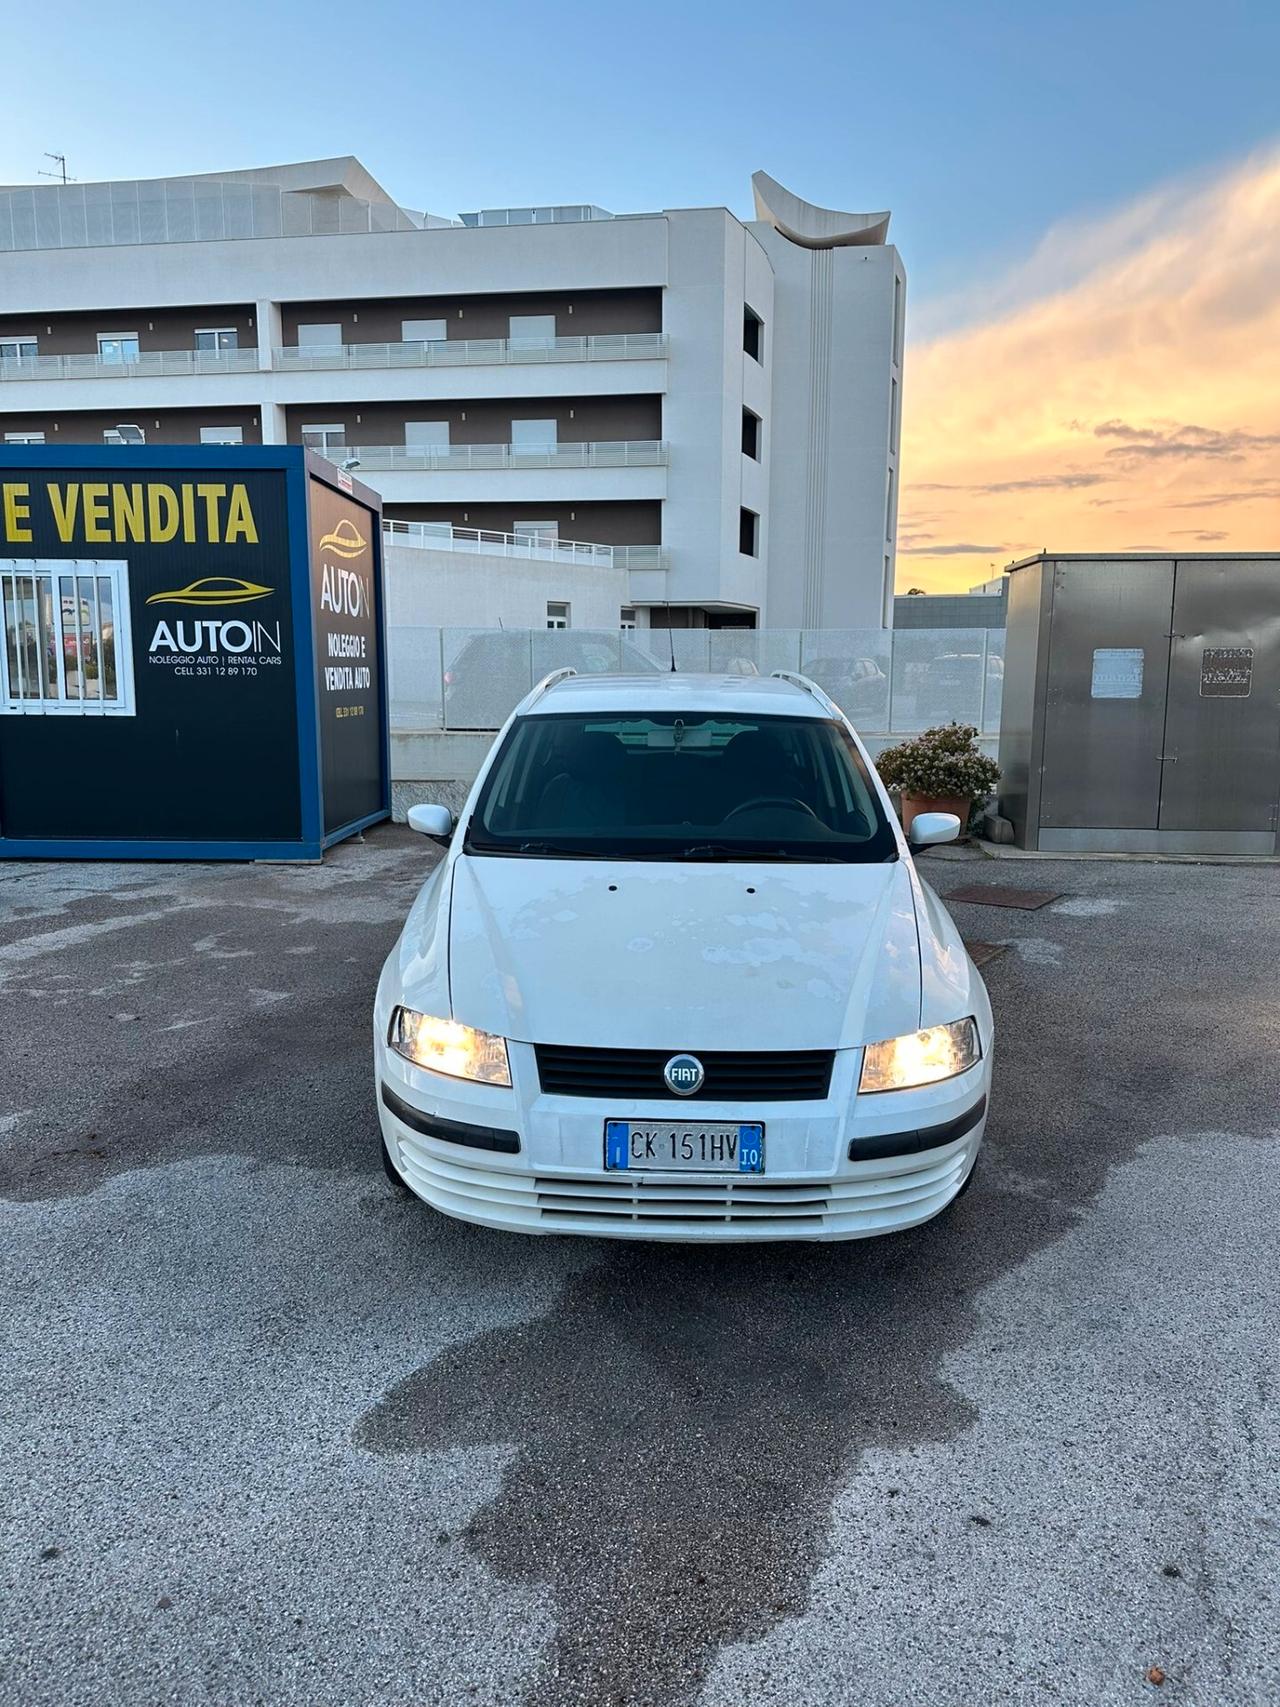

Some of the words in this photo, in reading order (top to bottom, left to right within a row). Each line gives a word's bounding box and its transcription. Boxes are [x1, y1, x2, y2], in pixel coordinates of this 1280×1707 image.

[2, 483, 33, 543] E
[47, 483, 259, 543] VENDITA
[148, 619, 281, 654] AUTOIN
[327, 632, 361, 658] NOLEGGIO
[361, 635, 366, 658] E
[148, 655, 196, 665] NOLEGGIO
[196, 656, 219, 665] AUTO
[227, 656, 257, 665] RENTAL
[258, 656, 282, 665] CARS
[174, 666, 195, 676] CELL
[196, 666, 212, 676] 331
[215, 666, 226, 676] 12
[227, 666, 239, 677] 89
[241, 666, 258, 677] 170
[324, 666, 354, 692] VENDITA
[354, 666, 371, 690] AUTO
[671, 1068, 698, 1082] FIAT
[631, 1131, 657, 1160] CK
[669, 1132, 738, 1162] 151HV
